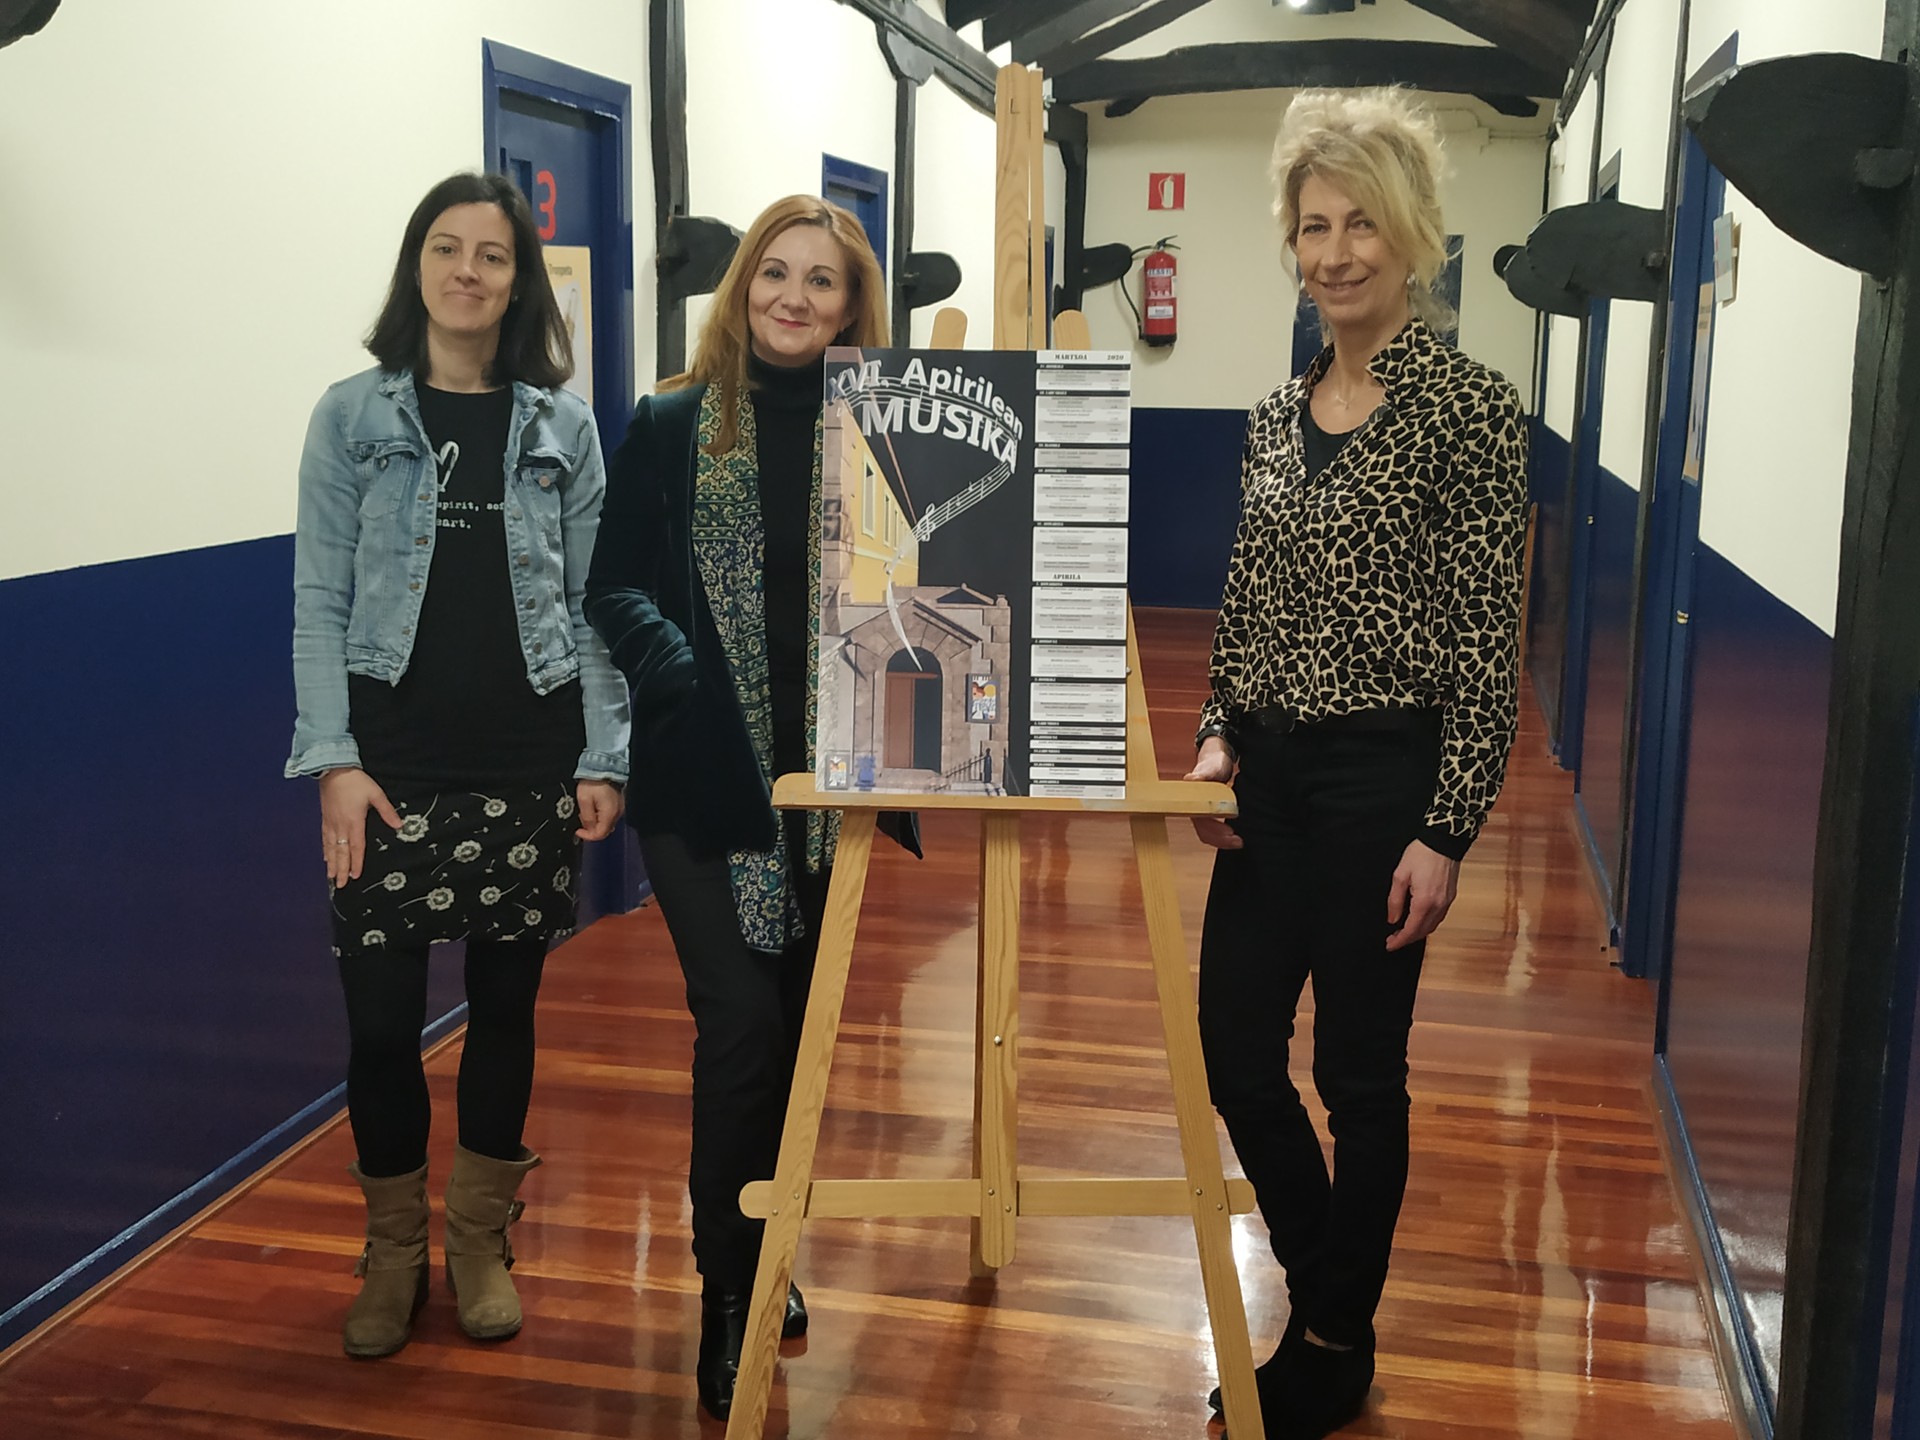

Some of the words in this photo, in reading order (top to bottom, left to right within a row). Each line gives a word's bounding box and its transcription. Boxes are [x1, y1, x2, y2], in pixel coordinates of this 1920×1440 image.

[536, 170, 557, 240] 3
[901, 357, 1023, 440] Apirilean
[862, 397, 1019, 475] MUSIKA
[436, 518, 472, 529] eart.
[486, 502, 505, 511] sof
